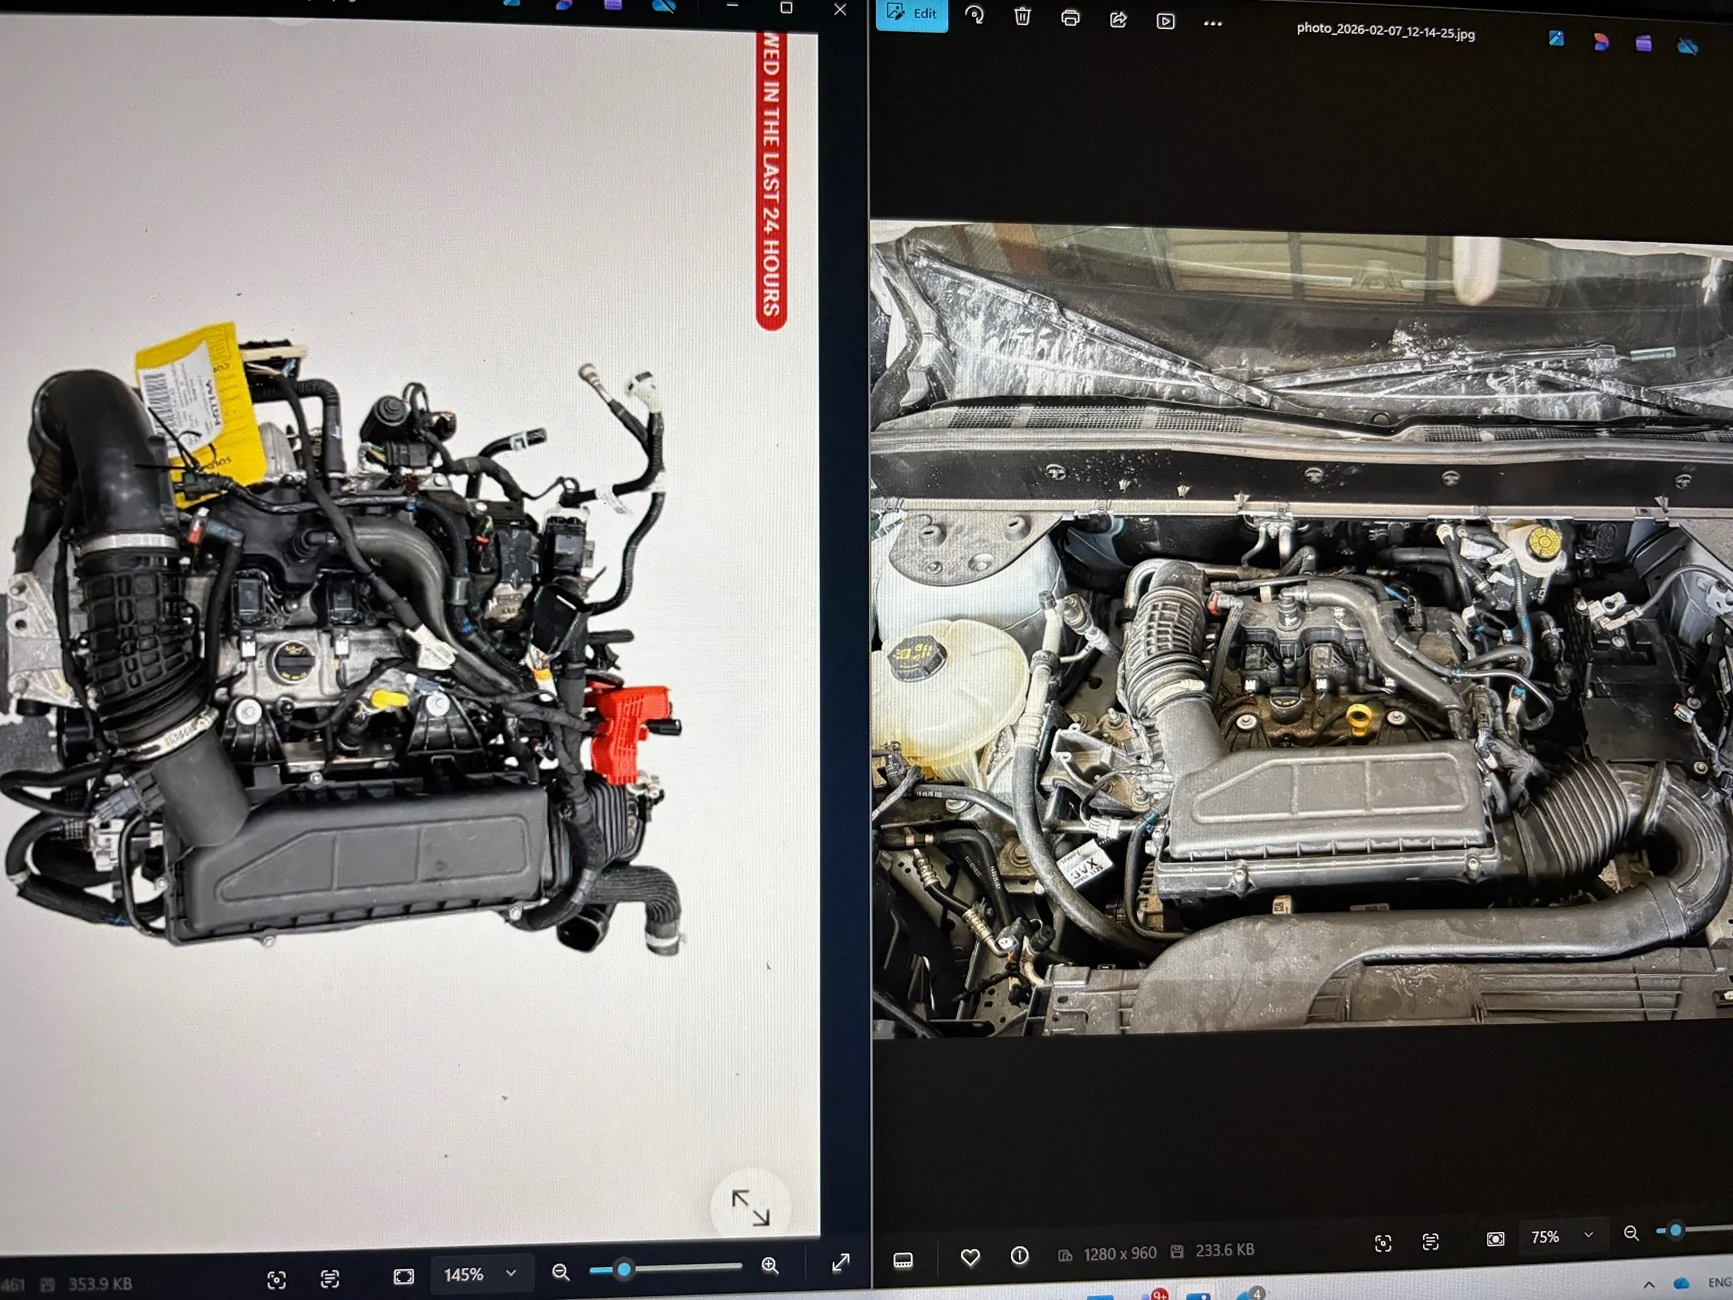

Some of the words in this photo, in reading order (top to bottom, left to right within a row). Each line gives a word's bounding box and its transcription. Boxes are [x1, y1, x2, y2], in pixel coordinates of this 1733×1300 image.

[914, 7, 937, 19] Edit
[1297, 21, 1476, 42] photo_2026-02-07_12-14-25.jpg
[763, 81, 780, 103] IN
[763, 107, 780, 147] THE
[763, 153, 780, 203] LAST
[763, 209, 780, 233] 24
[763, 240, 780, 317] HOURS
[1531, 1230, 1560, 1244] 75%
[1084, 1247, 1116, 1262] 1280
[1119, 1250, 1128, 1260] x
[1131, 1246, 1158, 1260] 960
[1196, 1243, 1233, 1258] 233.6
[1236, 1242, 1255, 1256] KB
[444, 1267, 485, 1282] 145%
[1708, 1276, 1732, 1288] ENG
[68, 1276, 109, 1292] 353.9
[112, 1276, 133, 1291] KB
[1153, 1291, 1168, 1300] 9+
[1253, 1289, 1262, 1300] 4
